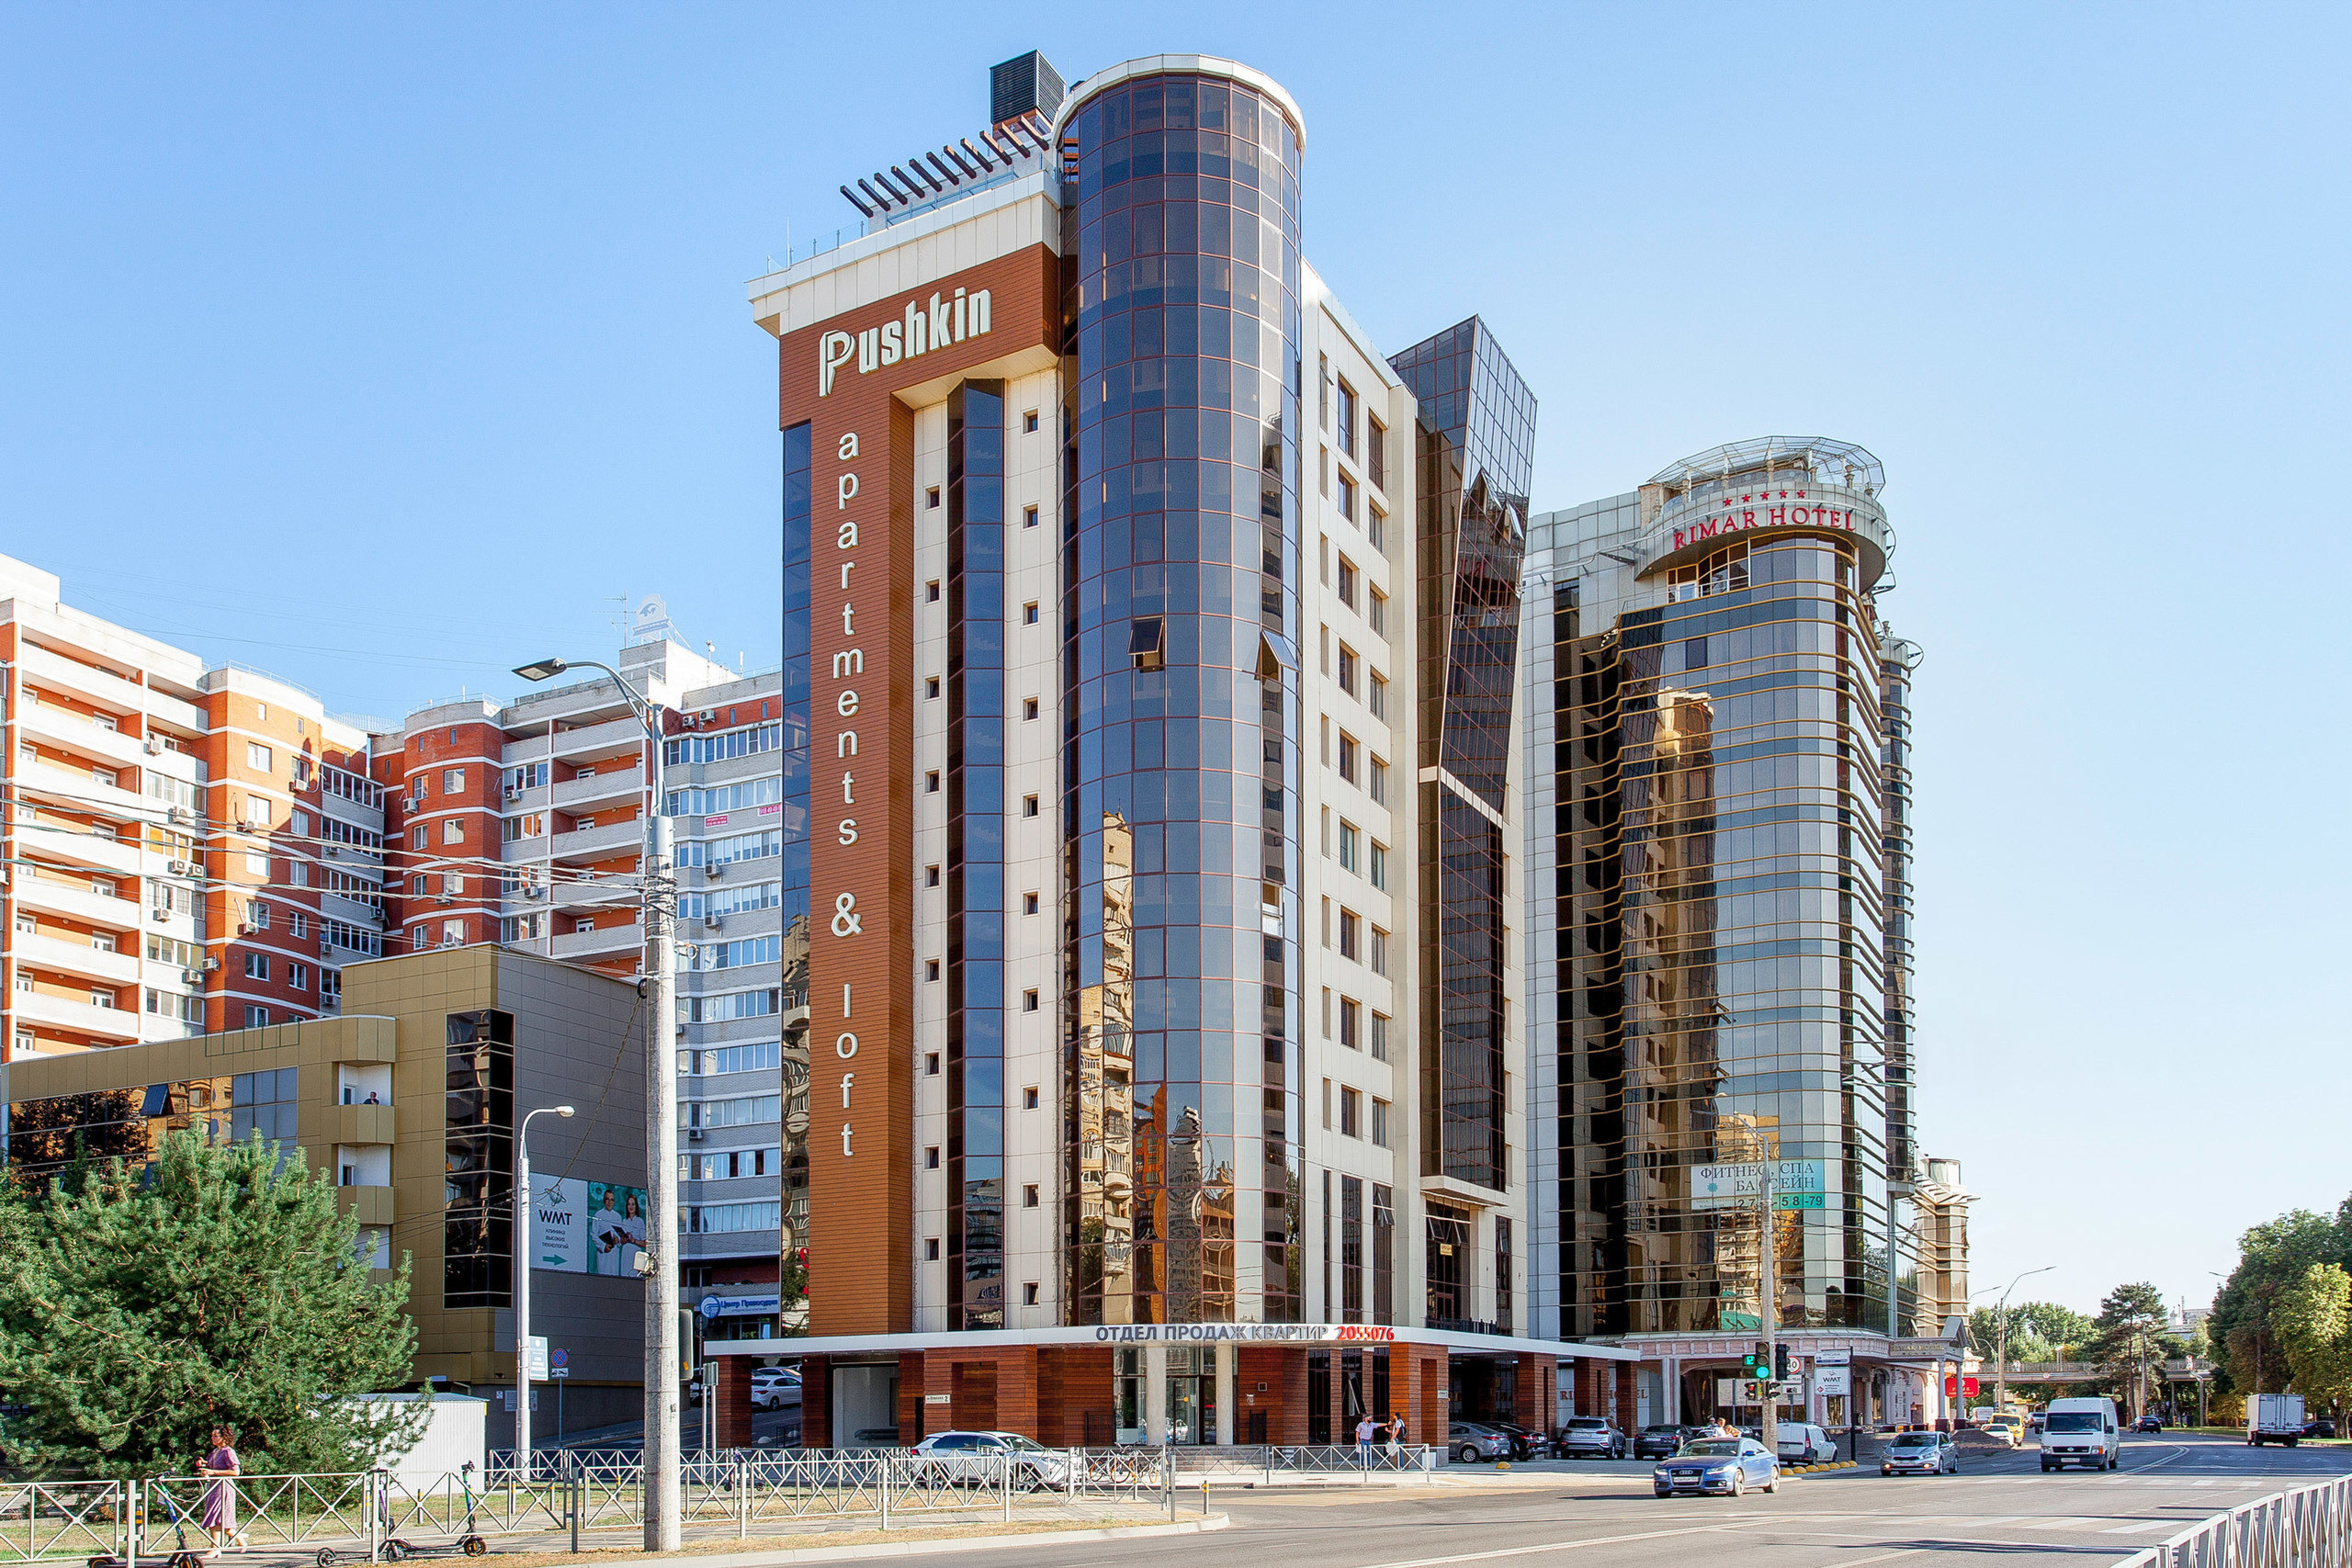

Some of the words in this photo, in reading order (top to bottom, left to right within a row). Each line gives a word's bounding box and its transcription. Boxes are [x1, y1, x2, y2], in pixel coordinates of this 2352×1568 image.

[820, 287, 992, 397] Pushkin
[1674, 511, 1758, 550] RIMAR
[1770, 507, 1856, 532] HOTEL
[832, 432, 864, 846] apartments
[831, 892, 863, 937] &
[836, 984, 859, 1156] loft
[1780, 1162, 1815, 1174] СПА
[538, 1209, 572, 1225] WMT
[1096, 1325, 1158, 1342] ОТДЕЛ
[1164, 1325, 1248, 1341] ПРОДАЖ
[1251, 1325, 1329, 1340] КВАРТИР
[1336, 1325, 1395, 1341] 2055076
